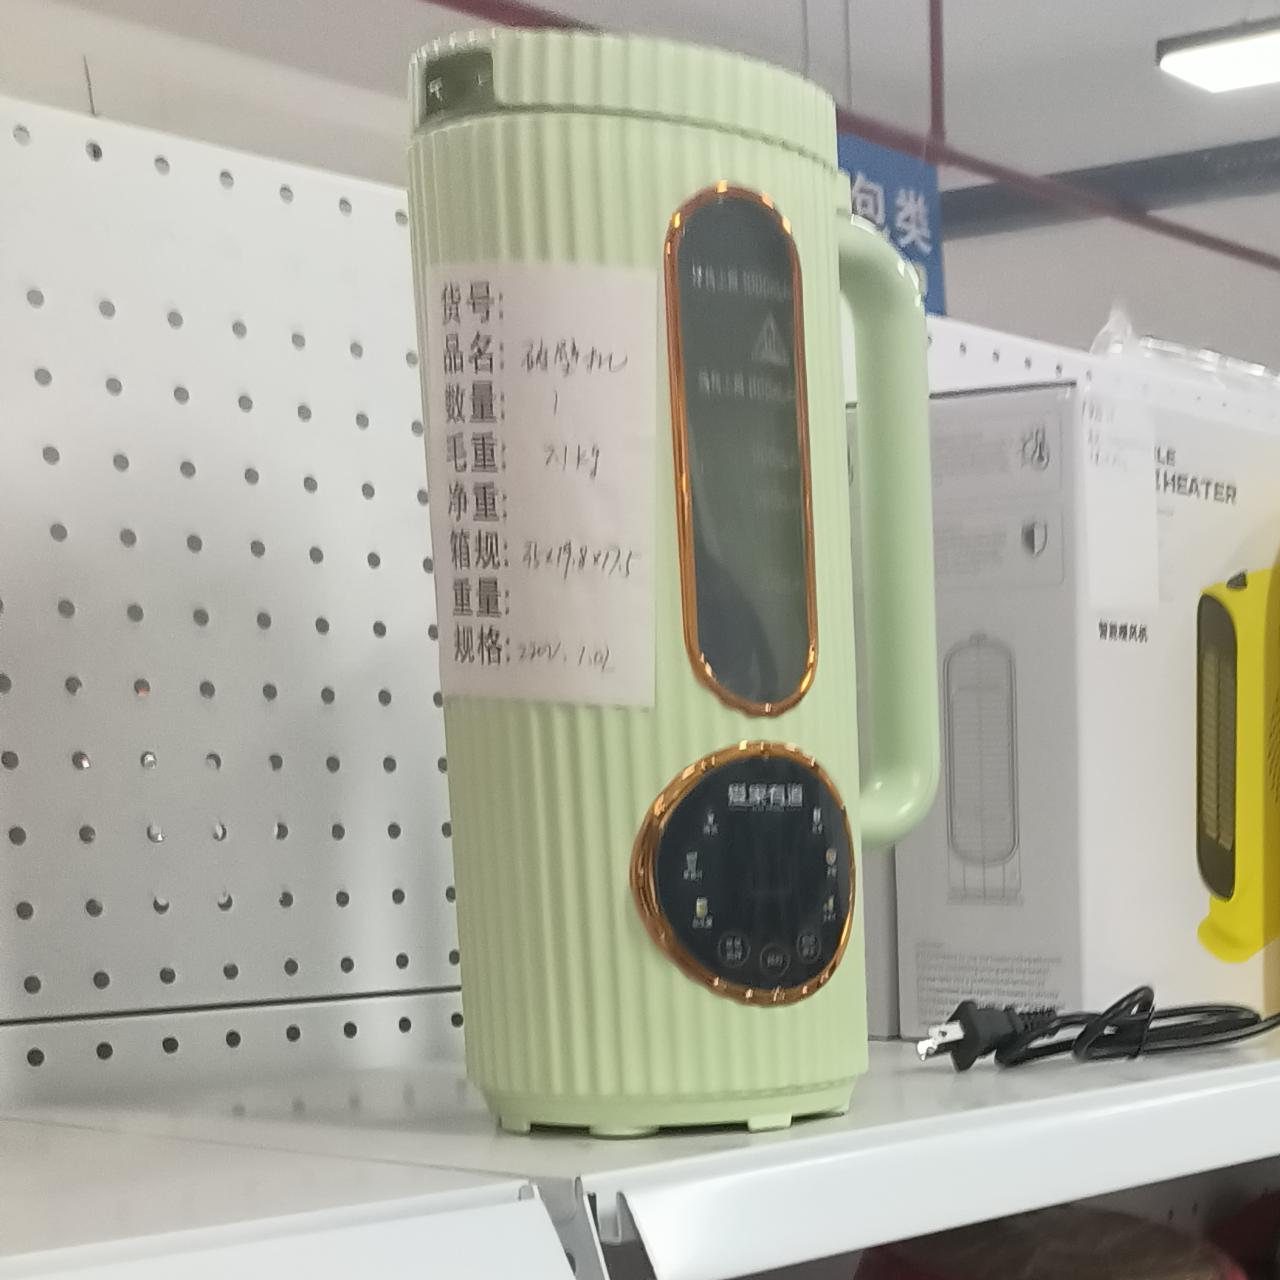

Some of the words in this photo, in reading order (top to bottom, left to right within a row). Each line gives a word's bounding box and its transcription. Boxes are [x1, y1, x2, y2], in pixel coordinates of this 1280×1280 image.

[443, 331, 504, 374] 品名:
[445, 380, 505, 424] 数量:
[446, 432, 507, 473] 毛重:
[448, 480, 508, 522] 净重:
[450, 529, 510, 570] 箱规:
[453, 577, 510, 618] 重量:
[454, 624, 511, 666] 规格:
